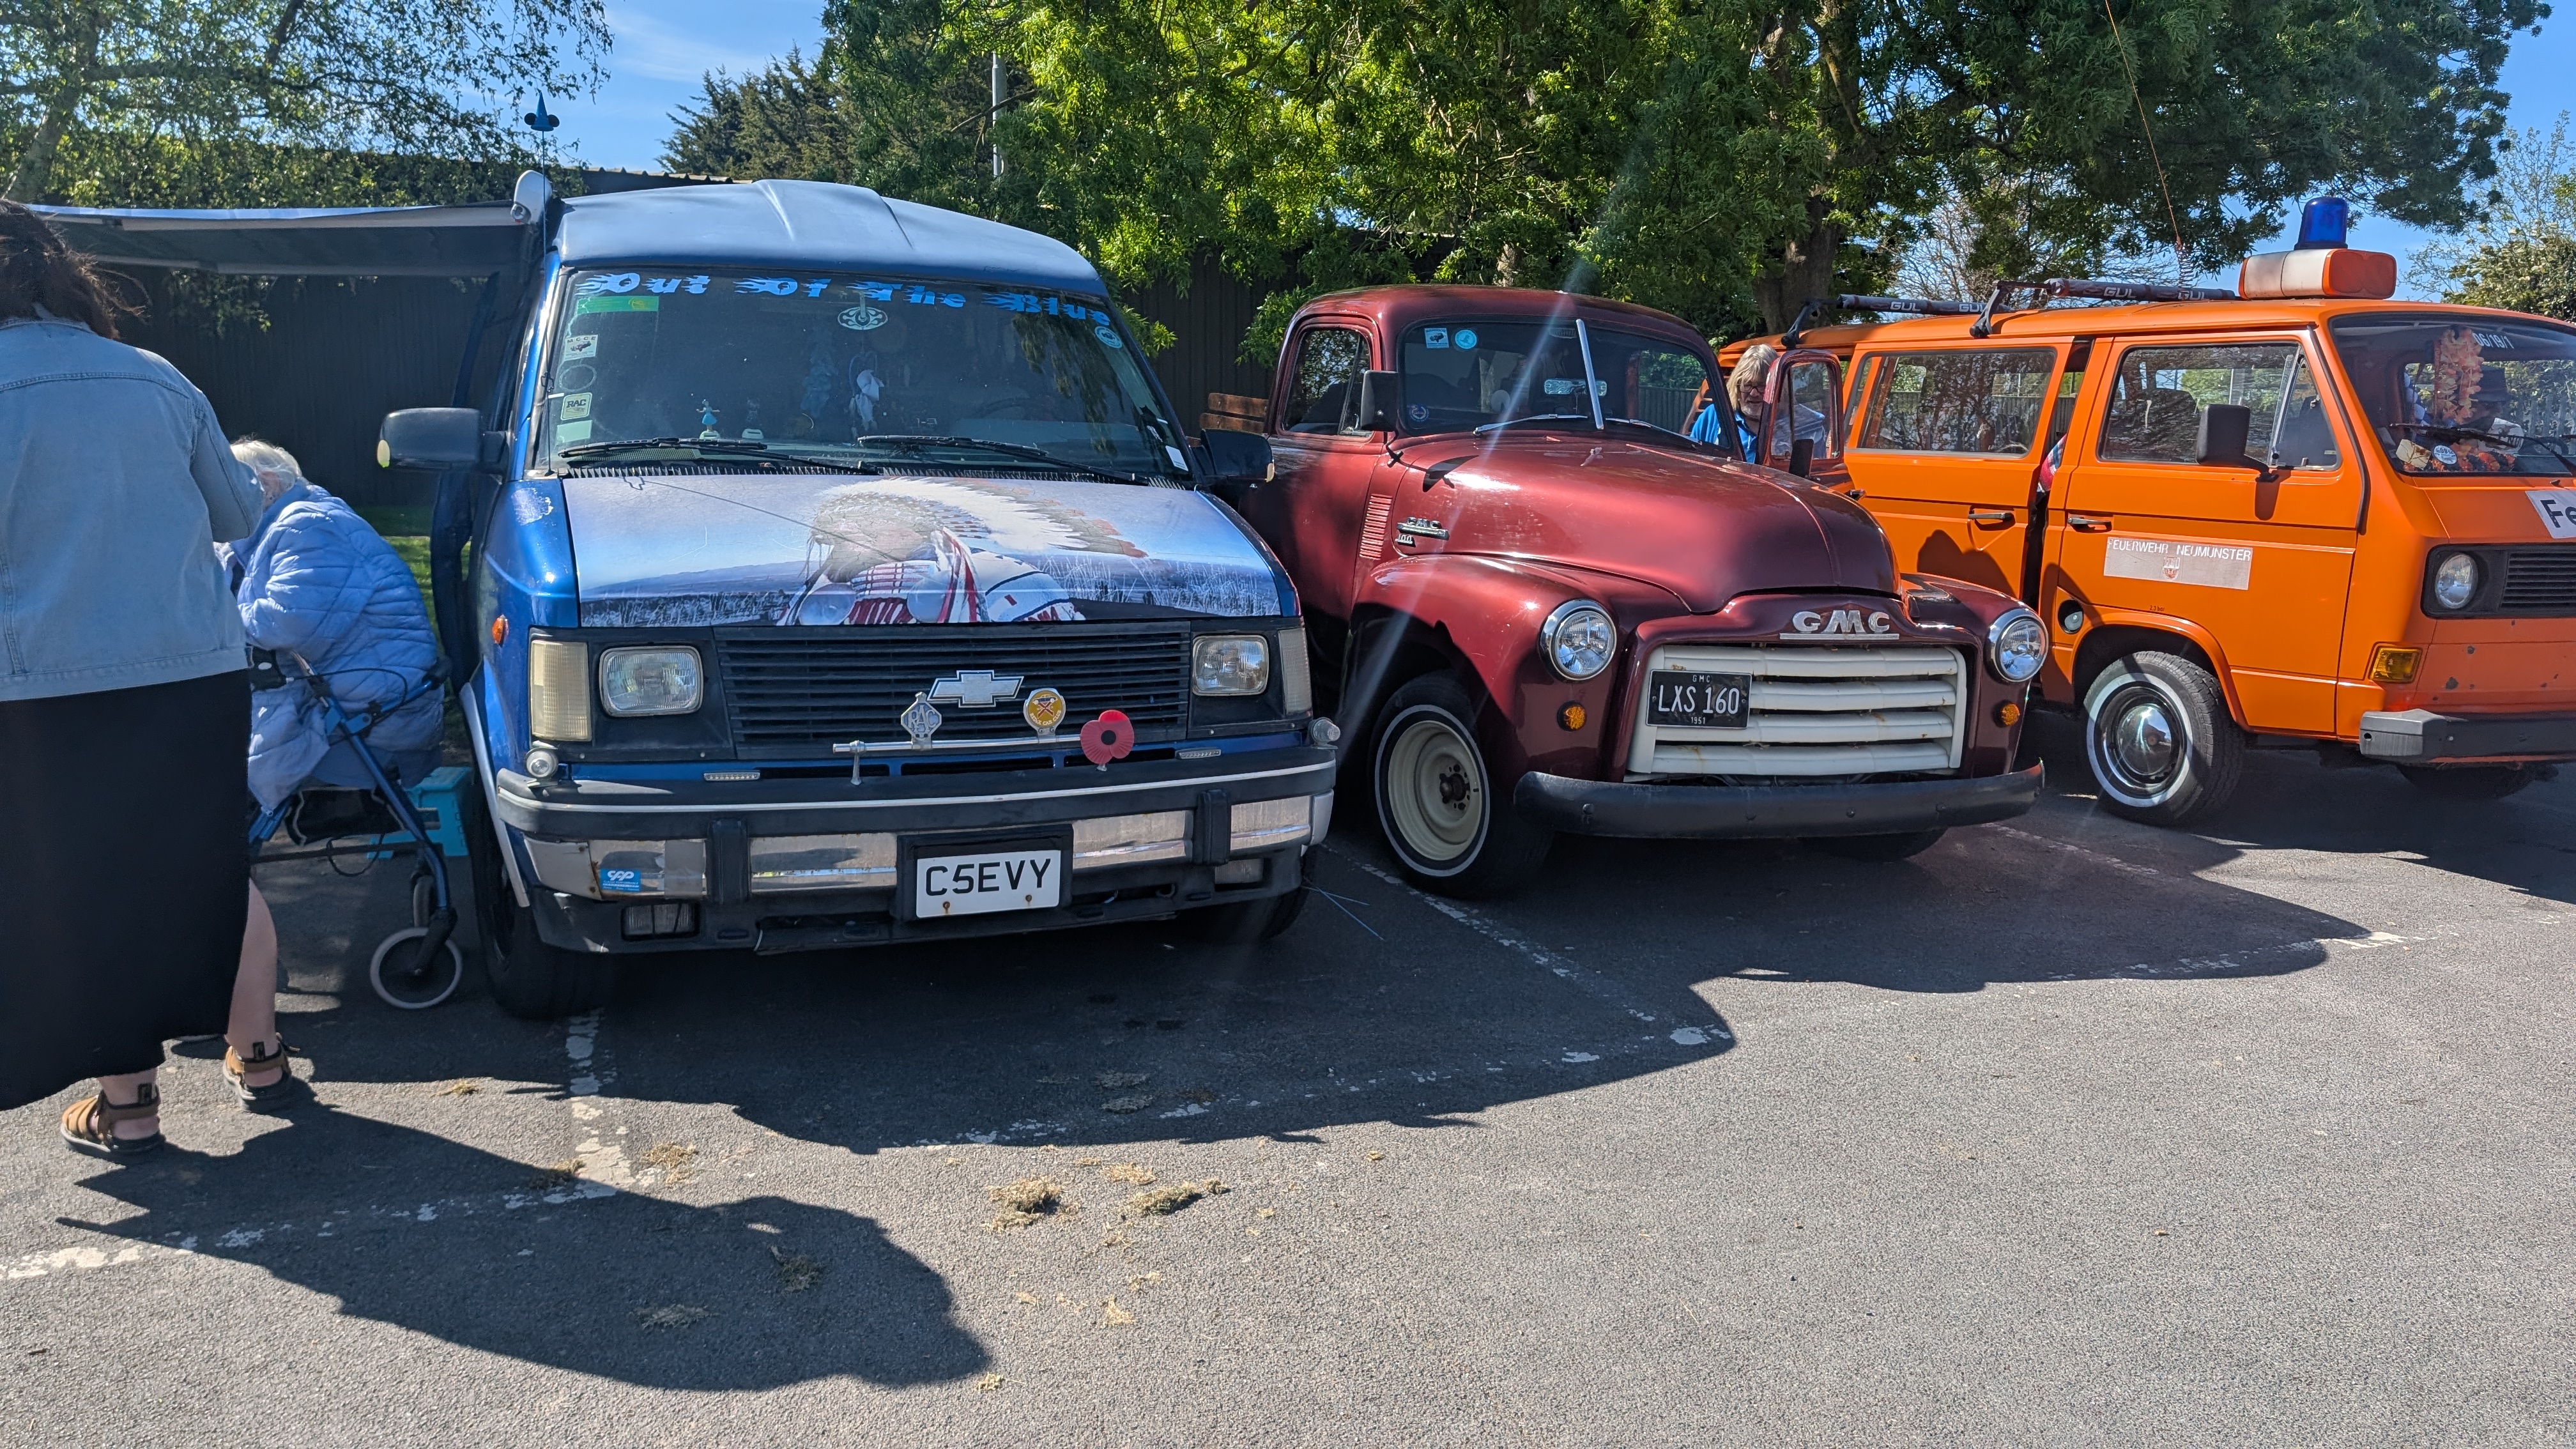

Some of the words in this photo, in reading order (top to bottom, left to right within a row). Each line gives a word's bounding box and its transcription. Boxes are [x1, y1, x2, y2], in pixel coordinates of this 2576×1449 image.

[2104, 287, 2136, 298] GUL
[2177, 291, 2211, 300] GUL
[575, 273, 710, 295] Out
[846, 280, 966, 308] The
[981, 292, 1110, 326] Blue
[1890, 301, 1921, 312] GUL
[566, 399, 586, 408] RAC
[1398, 533, 1412, 542] 100
[2107, 539, 2168, 554] FEUERWEHR
[1792, 610, 1891, 634] GMC
[1692, 674, 1710, 683] GMC
[1658, 684, 1696, 712] LXS
[1702, 687, 1740, 714] 160
[908, 705, 937, 733] RAC
[1690, 716, 1706, 724] 1951
[925, 858, 1051, 896] C5EVY
